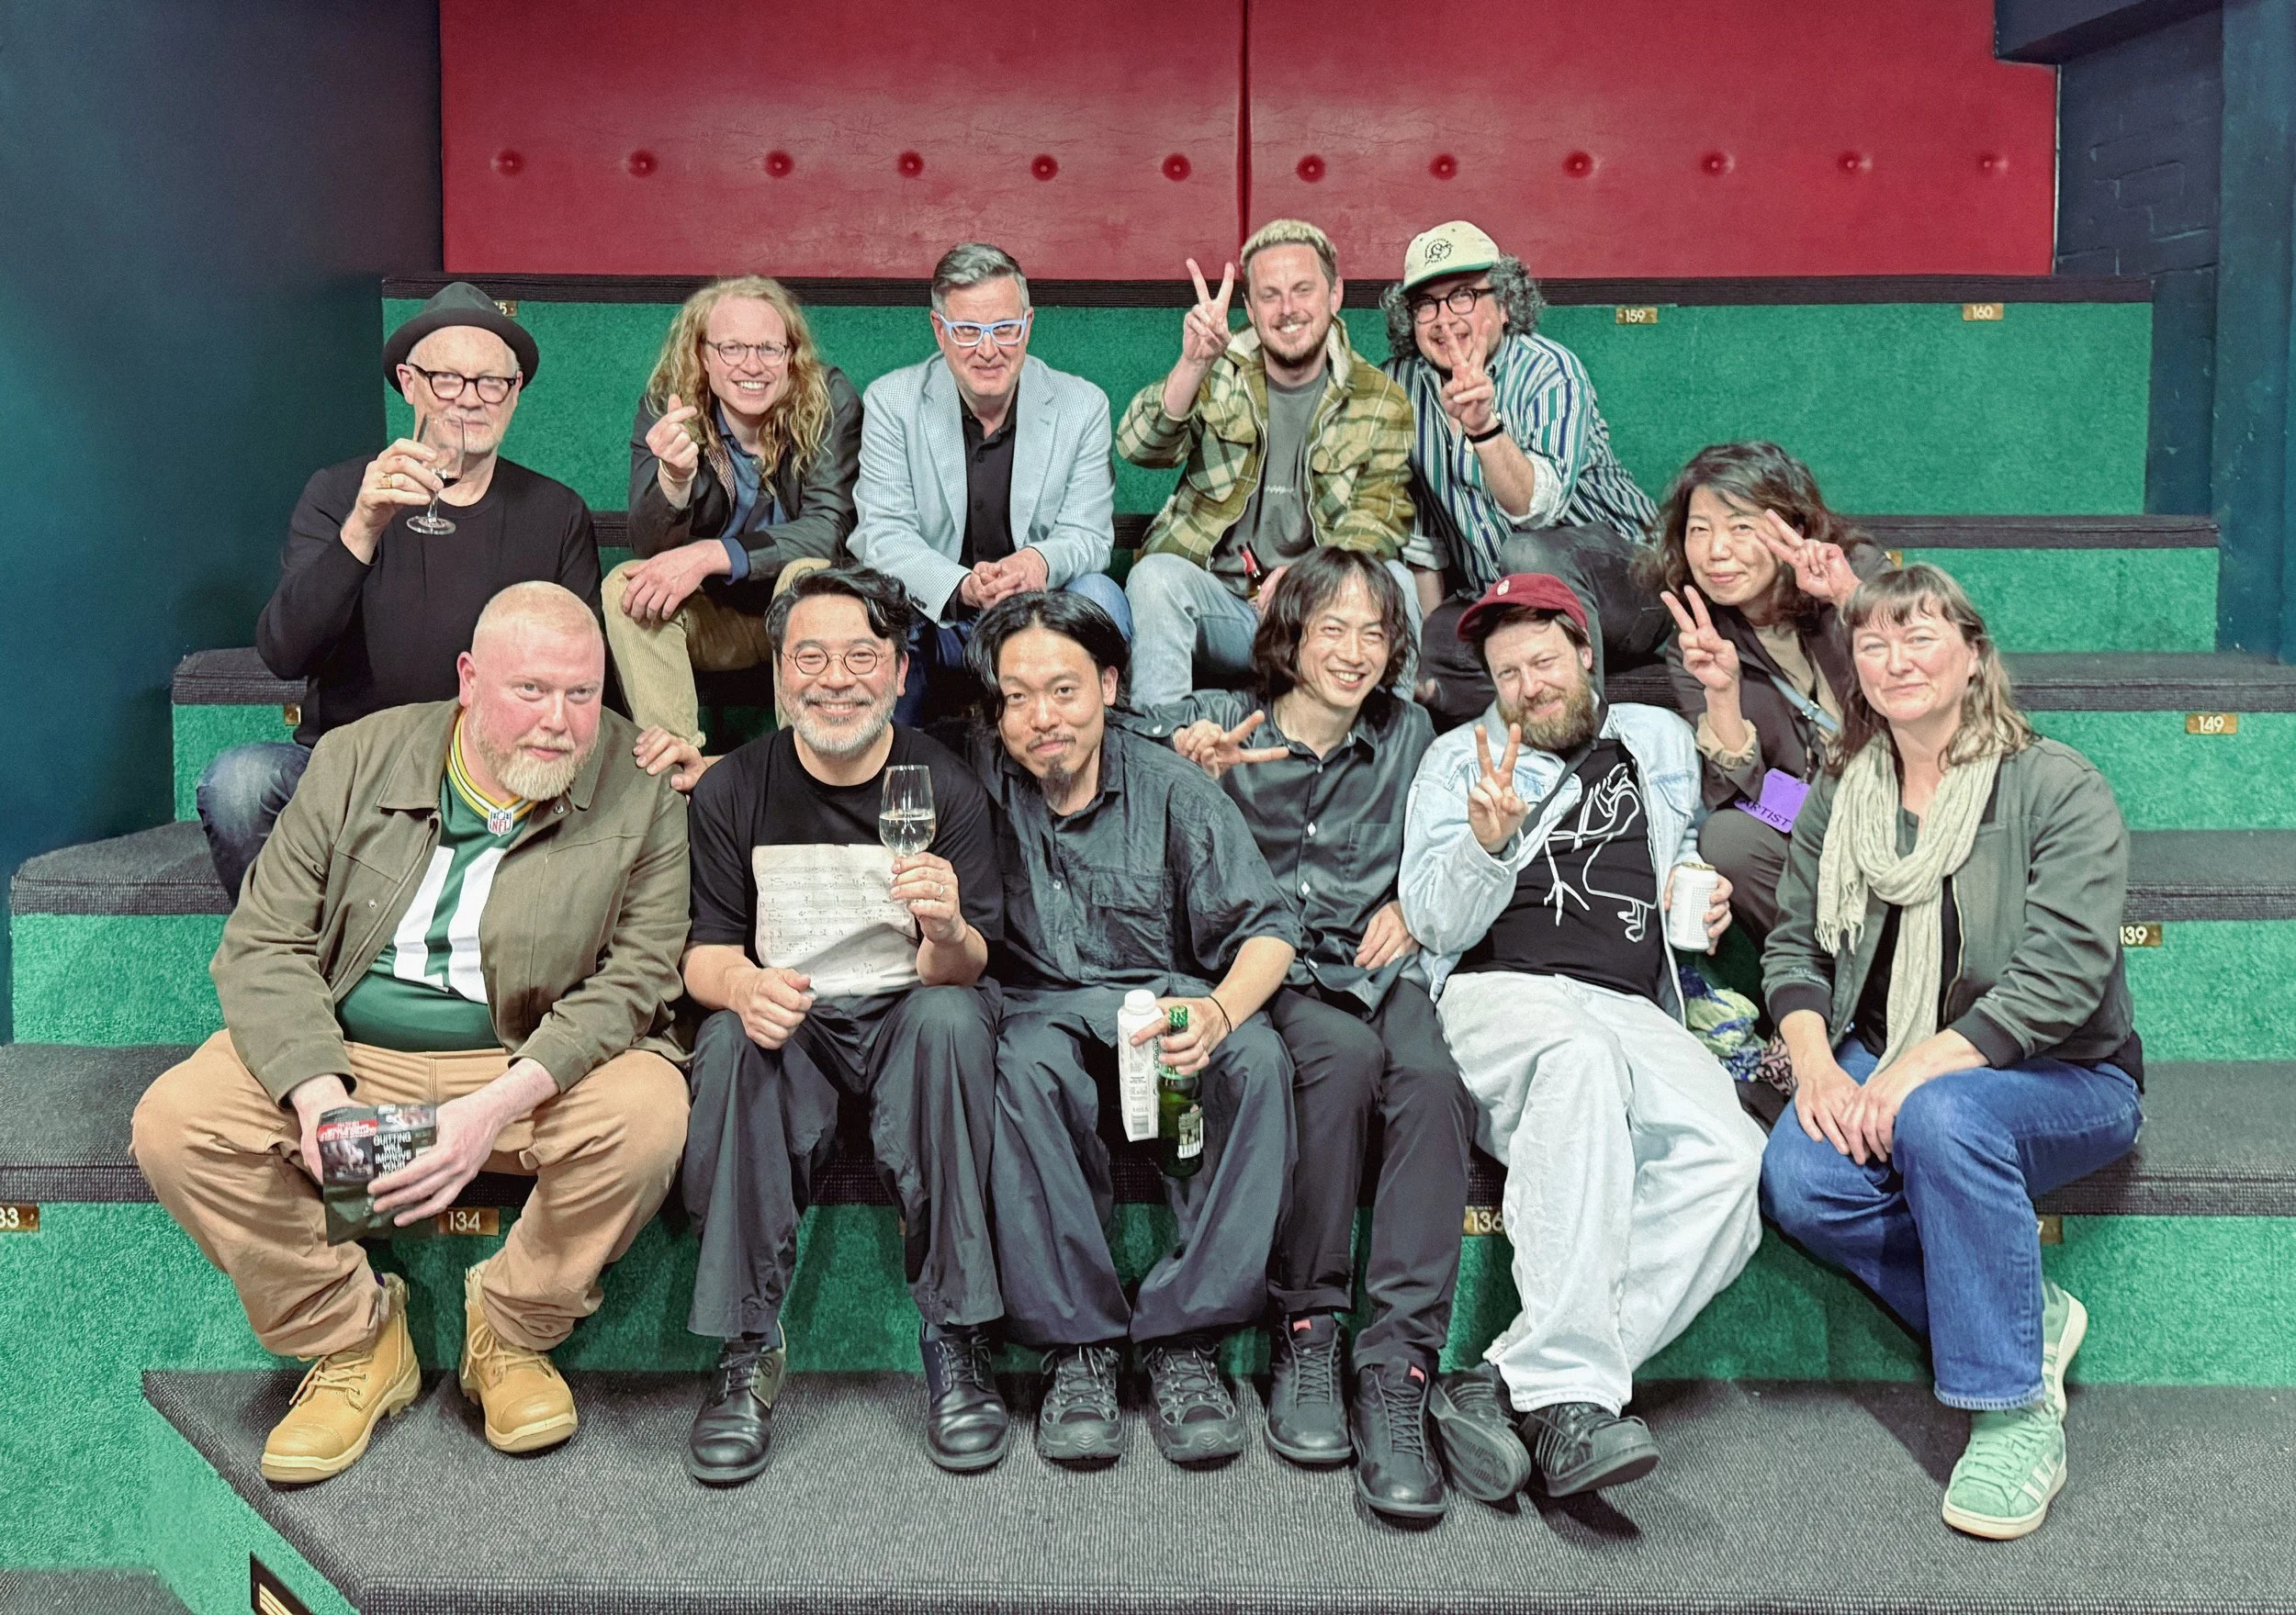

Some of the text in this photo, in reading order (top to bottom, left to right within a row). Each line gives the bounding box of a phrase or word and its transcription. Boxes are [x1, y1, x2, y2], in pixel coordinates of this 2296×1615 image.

[1625, 308, 1647, 323] 159
[1972, 305, 1994, 320] 160
[2198, 715, 2225, 734] 149
[1738, 799, 1792, 826] ARTIST
[491, 819, 508, 833] NFL
[2120, 925, 2148, 945] 139
[448, 1210, 481, 1232] 134
[1471, 1211, 1504, 1233] 136
